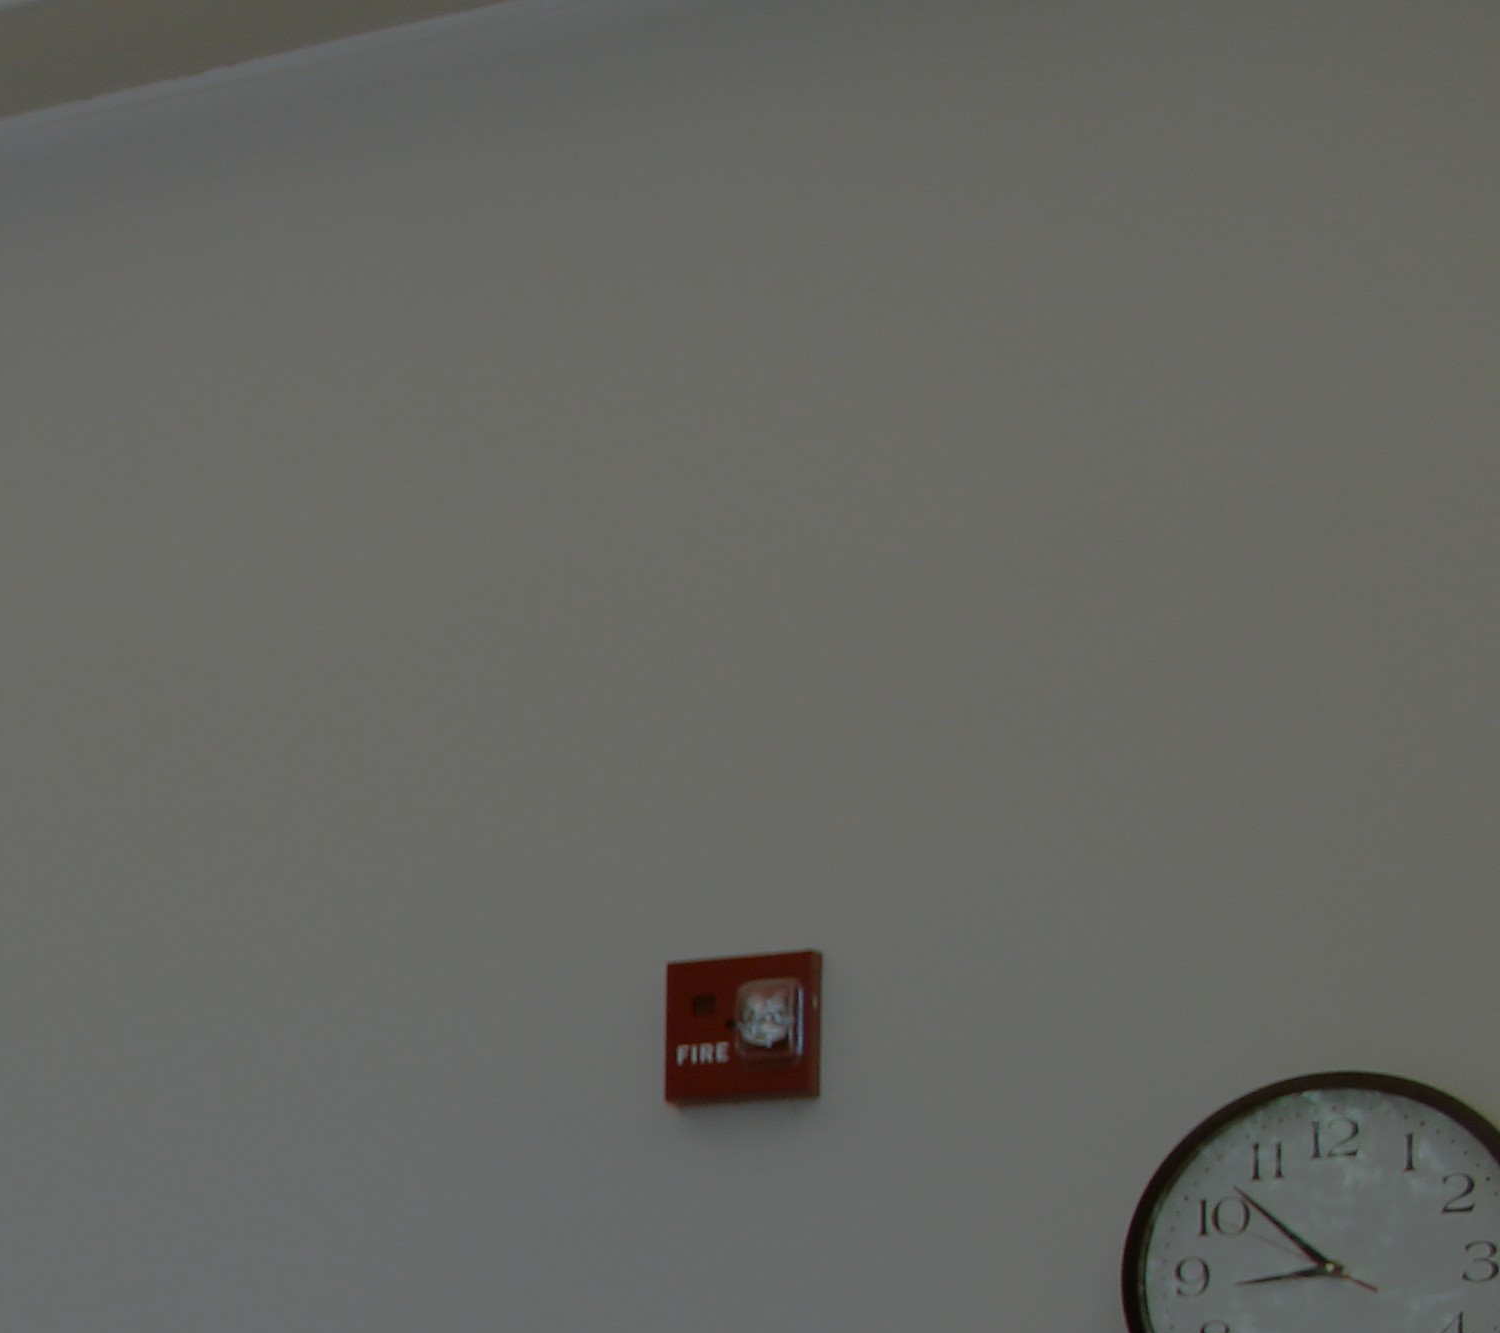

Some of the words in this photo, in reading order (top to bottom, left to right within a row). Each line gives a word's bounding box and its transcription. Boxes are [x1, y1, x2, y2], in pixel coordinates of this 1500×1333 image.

[676, 1041, 730, 1066] FIRE
[1311, 1116, 1359, 1158] 12
[1403, 1133, 1414, 1172] 1
[1251, 1142, 1283, 1181] 11
[1441, 1173, 1475, 1214] 2
[1199, 1196, 1250, 1236] 10
[1174, 1256, 1209, 1297] 9
[1462, 1240, 1499, 1282] 3
